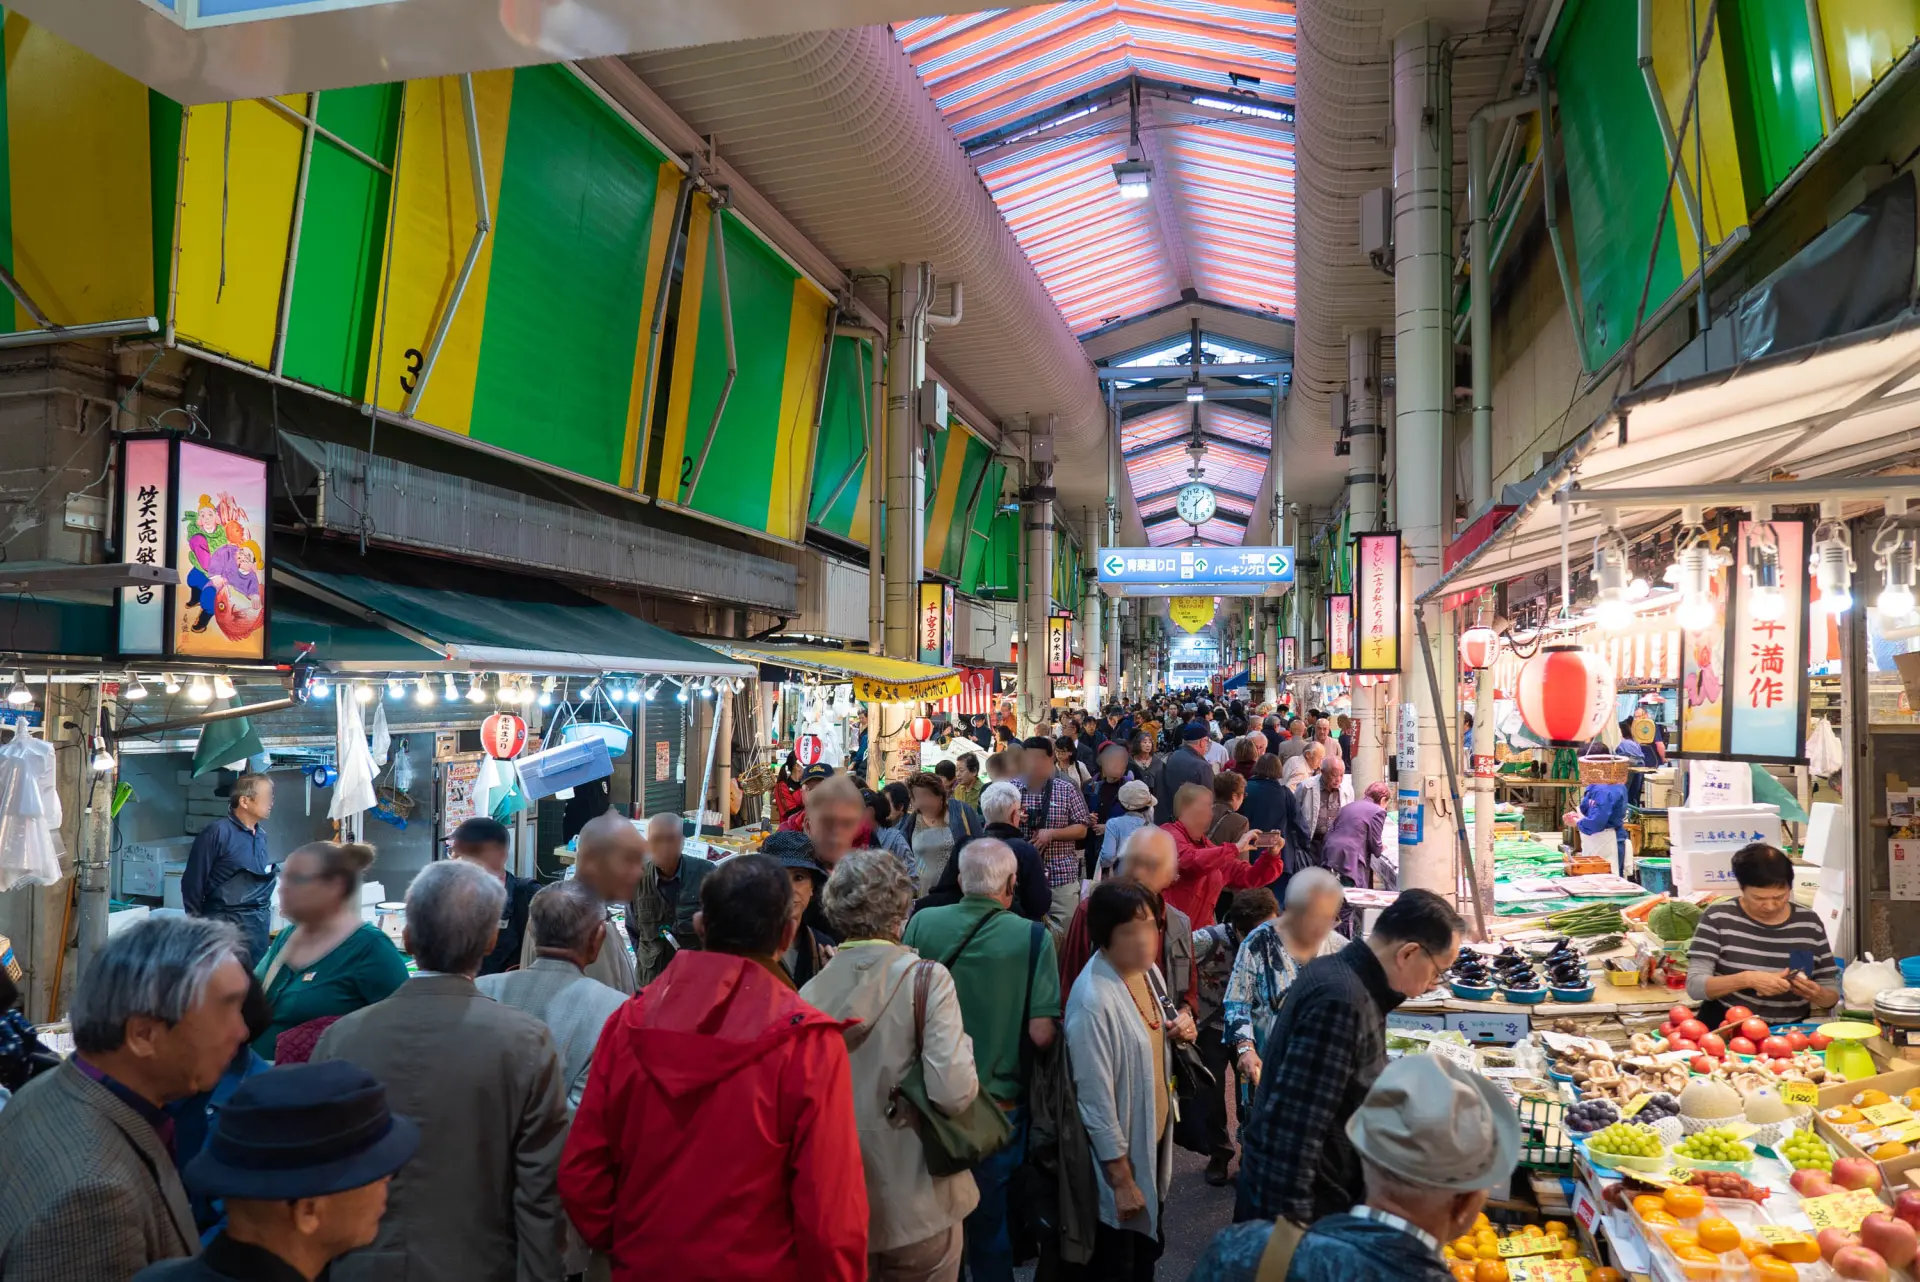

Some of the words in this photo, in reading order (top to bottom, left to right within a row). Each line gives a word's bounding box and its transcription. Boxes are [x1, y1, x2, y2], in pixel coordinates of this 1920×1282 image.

[400, 348, 424, 395] 3
[680, 456, 693, 487] 2
[1126, 559, 1176, 573] 青果通り口
[1214, 564, 1265, 576] パーキング口
[925, 601, 938, 651] 千客万来
[1052, 627, 1062, 661] 大口水産
[1748, 592, 1786, 708] 年満作
[500, 717, 510, 750] 市場まつり
